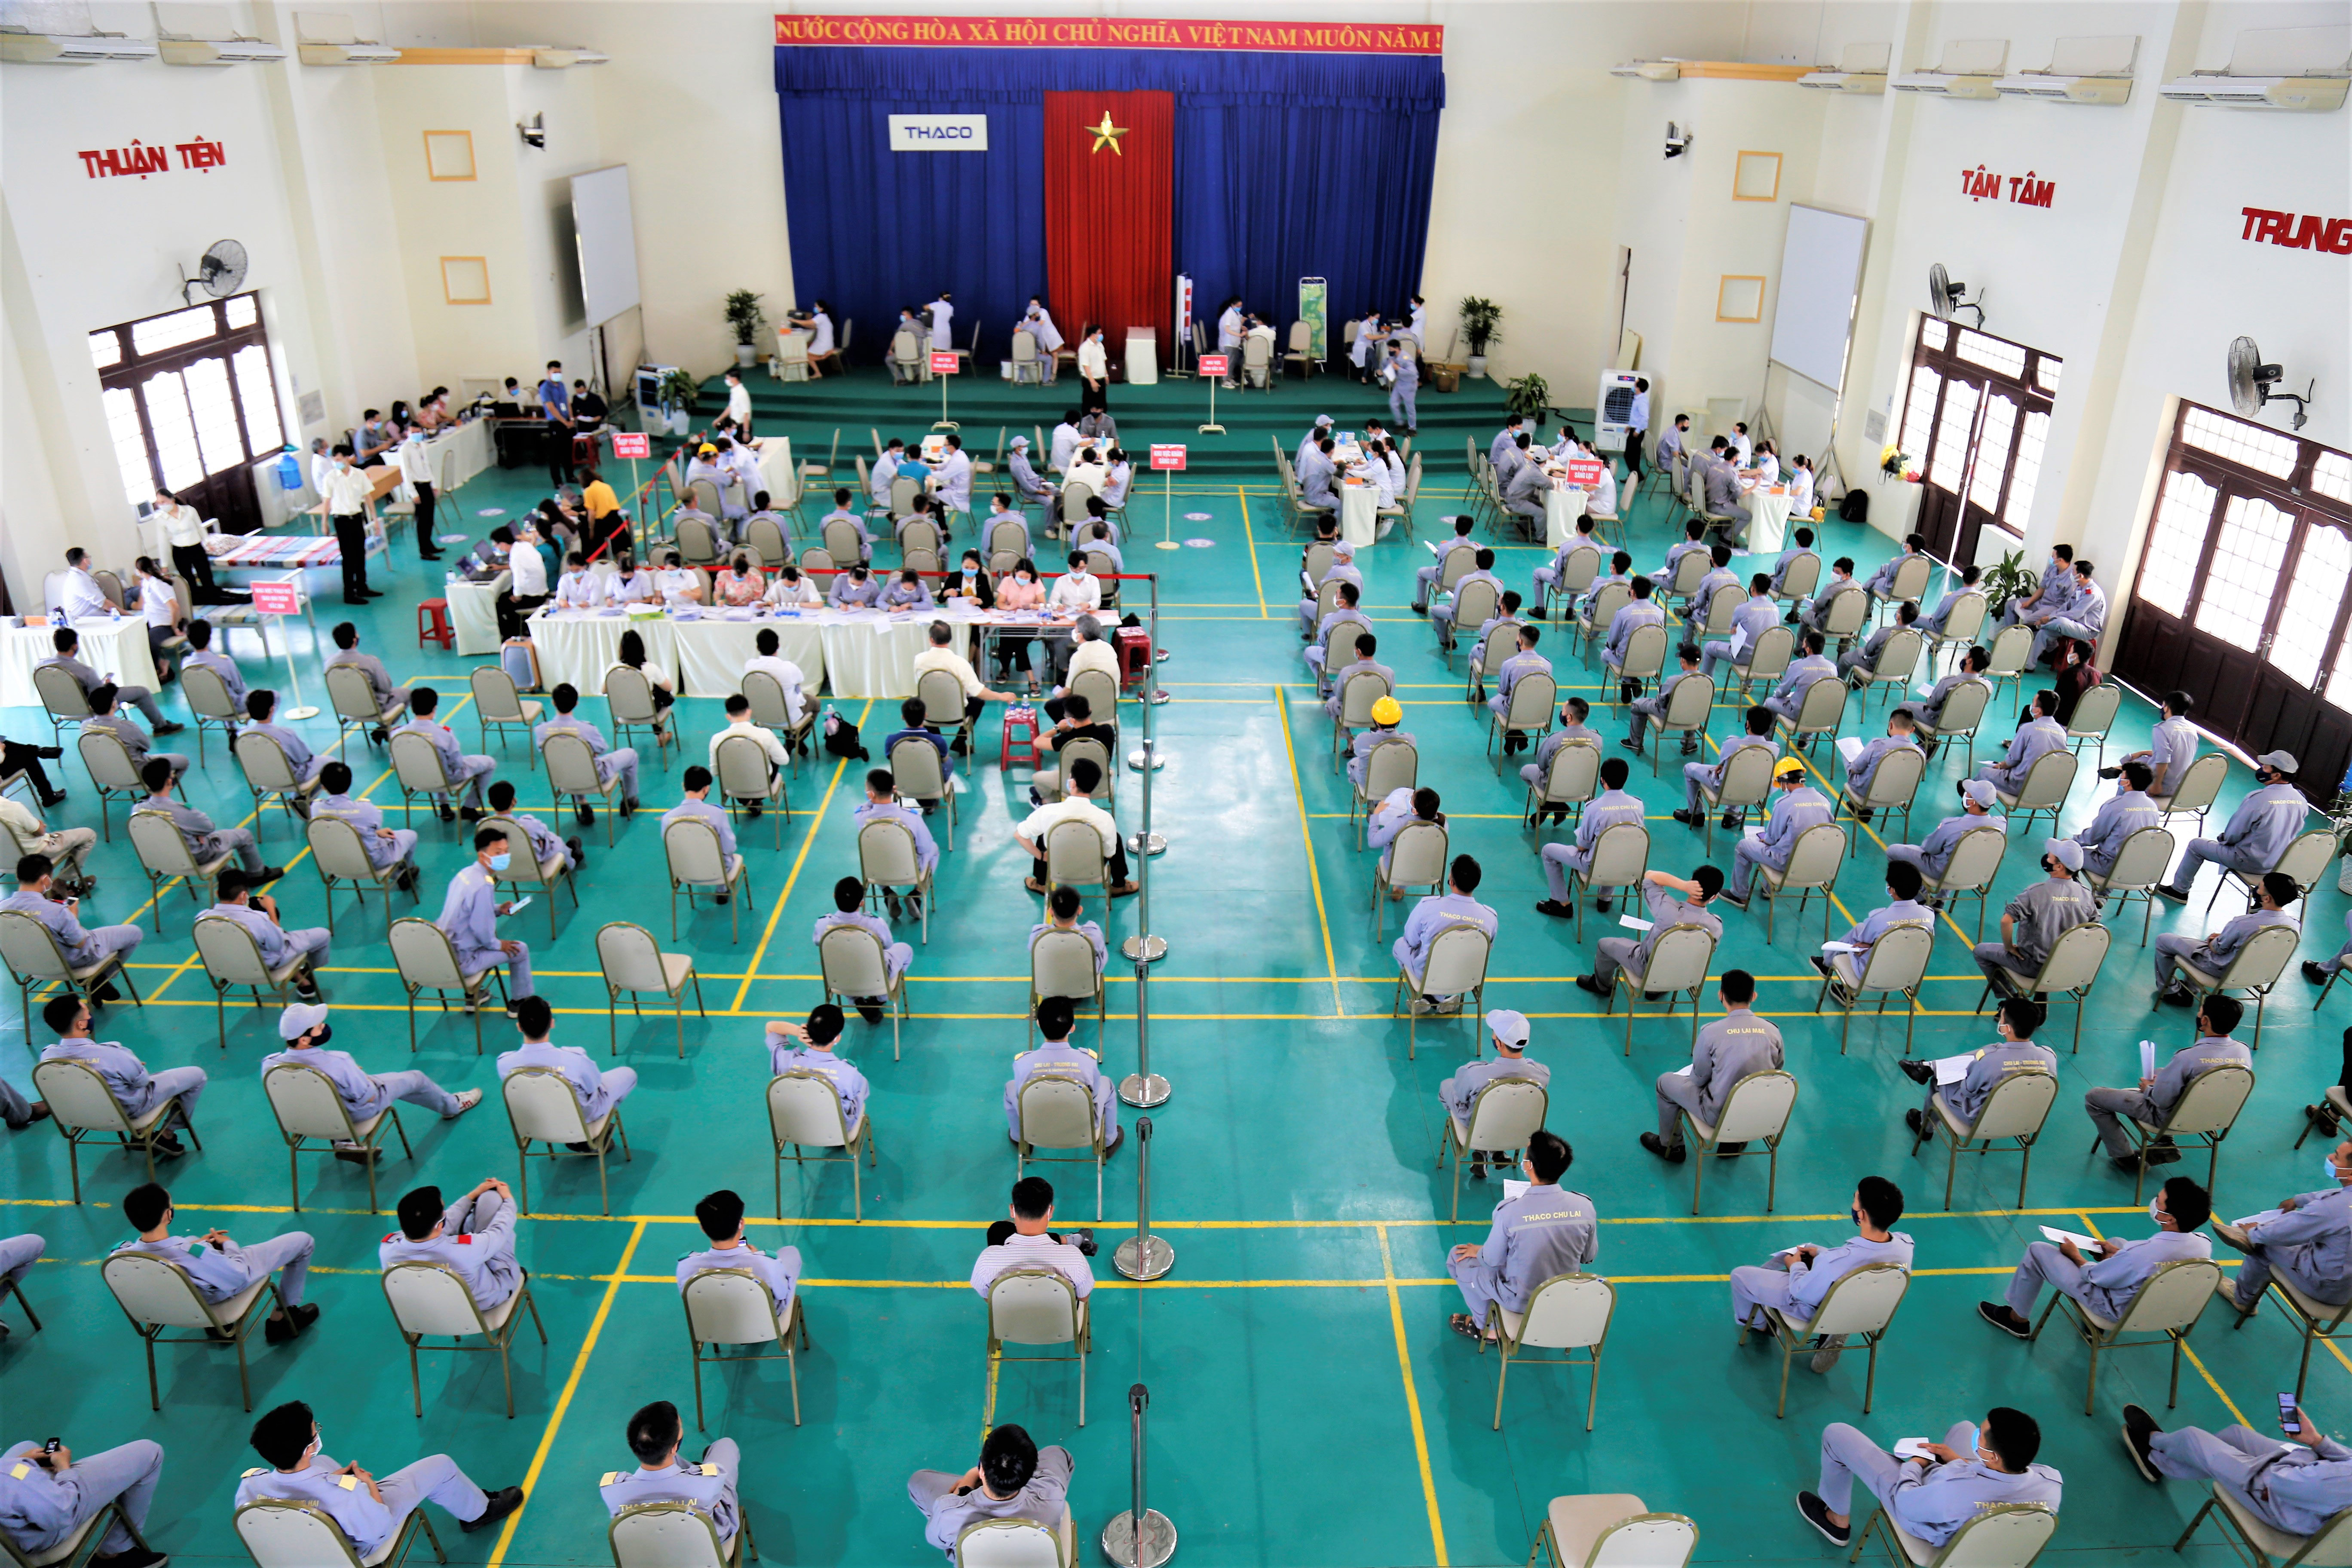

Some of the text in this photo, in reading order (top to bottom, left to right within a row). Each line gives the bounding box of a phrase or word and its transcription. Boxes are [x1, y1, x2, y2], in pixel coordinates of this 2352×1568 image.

[777, 15, 841, 40] NƯỚC
[843, 18, 909, 43] CỘNG
[914, 18, 962, 41] HÒA
[968, 19, 999, 41] XÃ
[1005, 18, 1048, 45] HỘI
[1053, 18, 1102, 41] CHỦ
[1108, 21, 1182, 43] NGHĨA
[1188, 22, 1243, 47] VIỆT
[1246, 27, 1297, 46] NAM
[1303, 24, 1372, 47] MUÔN
[1377, 26, 1430, 48] NĂM
[904, 126, 972, 138] THACO
[78, 135, 227, 180] THUẬN TIỆN
[1962, 164, 2055, 208] TẬN TÂM
[2242, 207, 2352, 255] TRUNG
[1439, 912, 1461, 920] THACO
[1522, 1213, 1551, 1222] THACO
